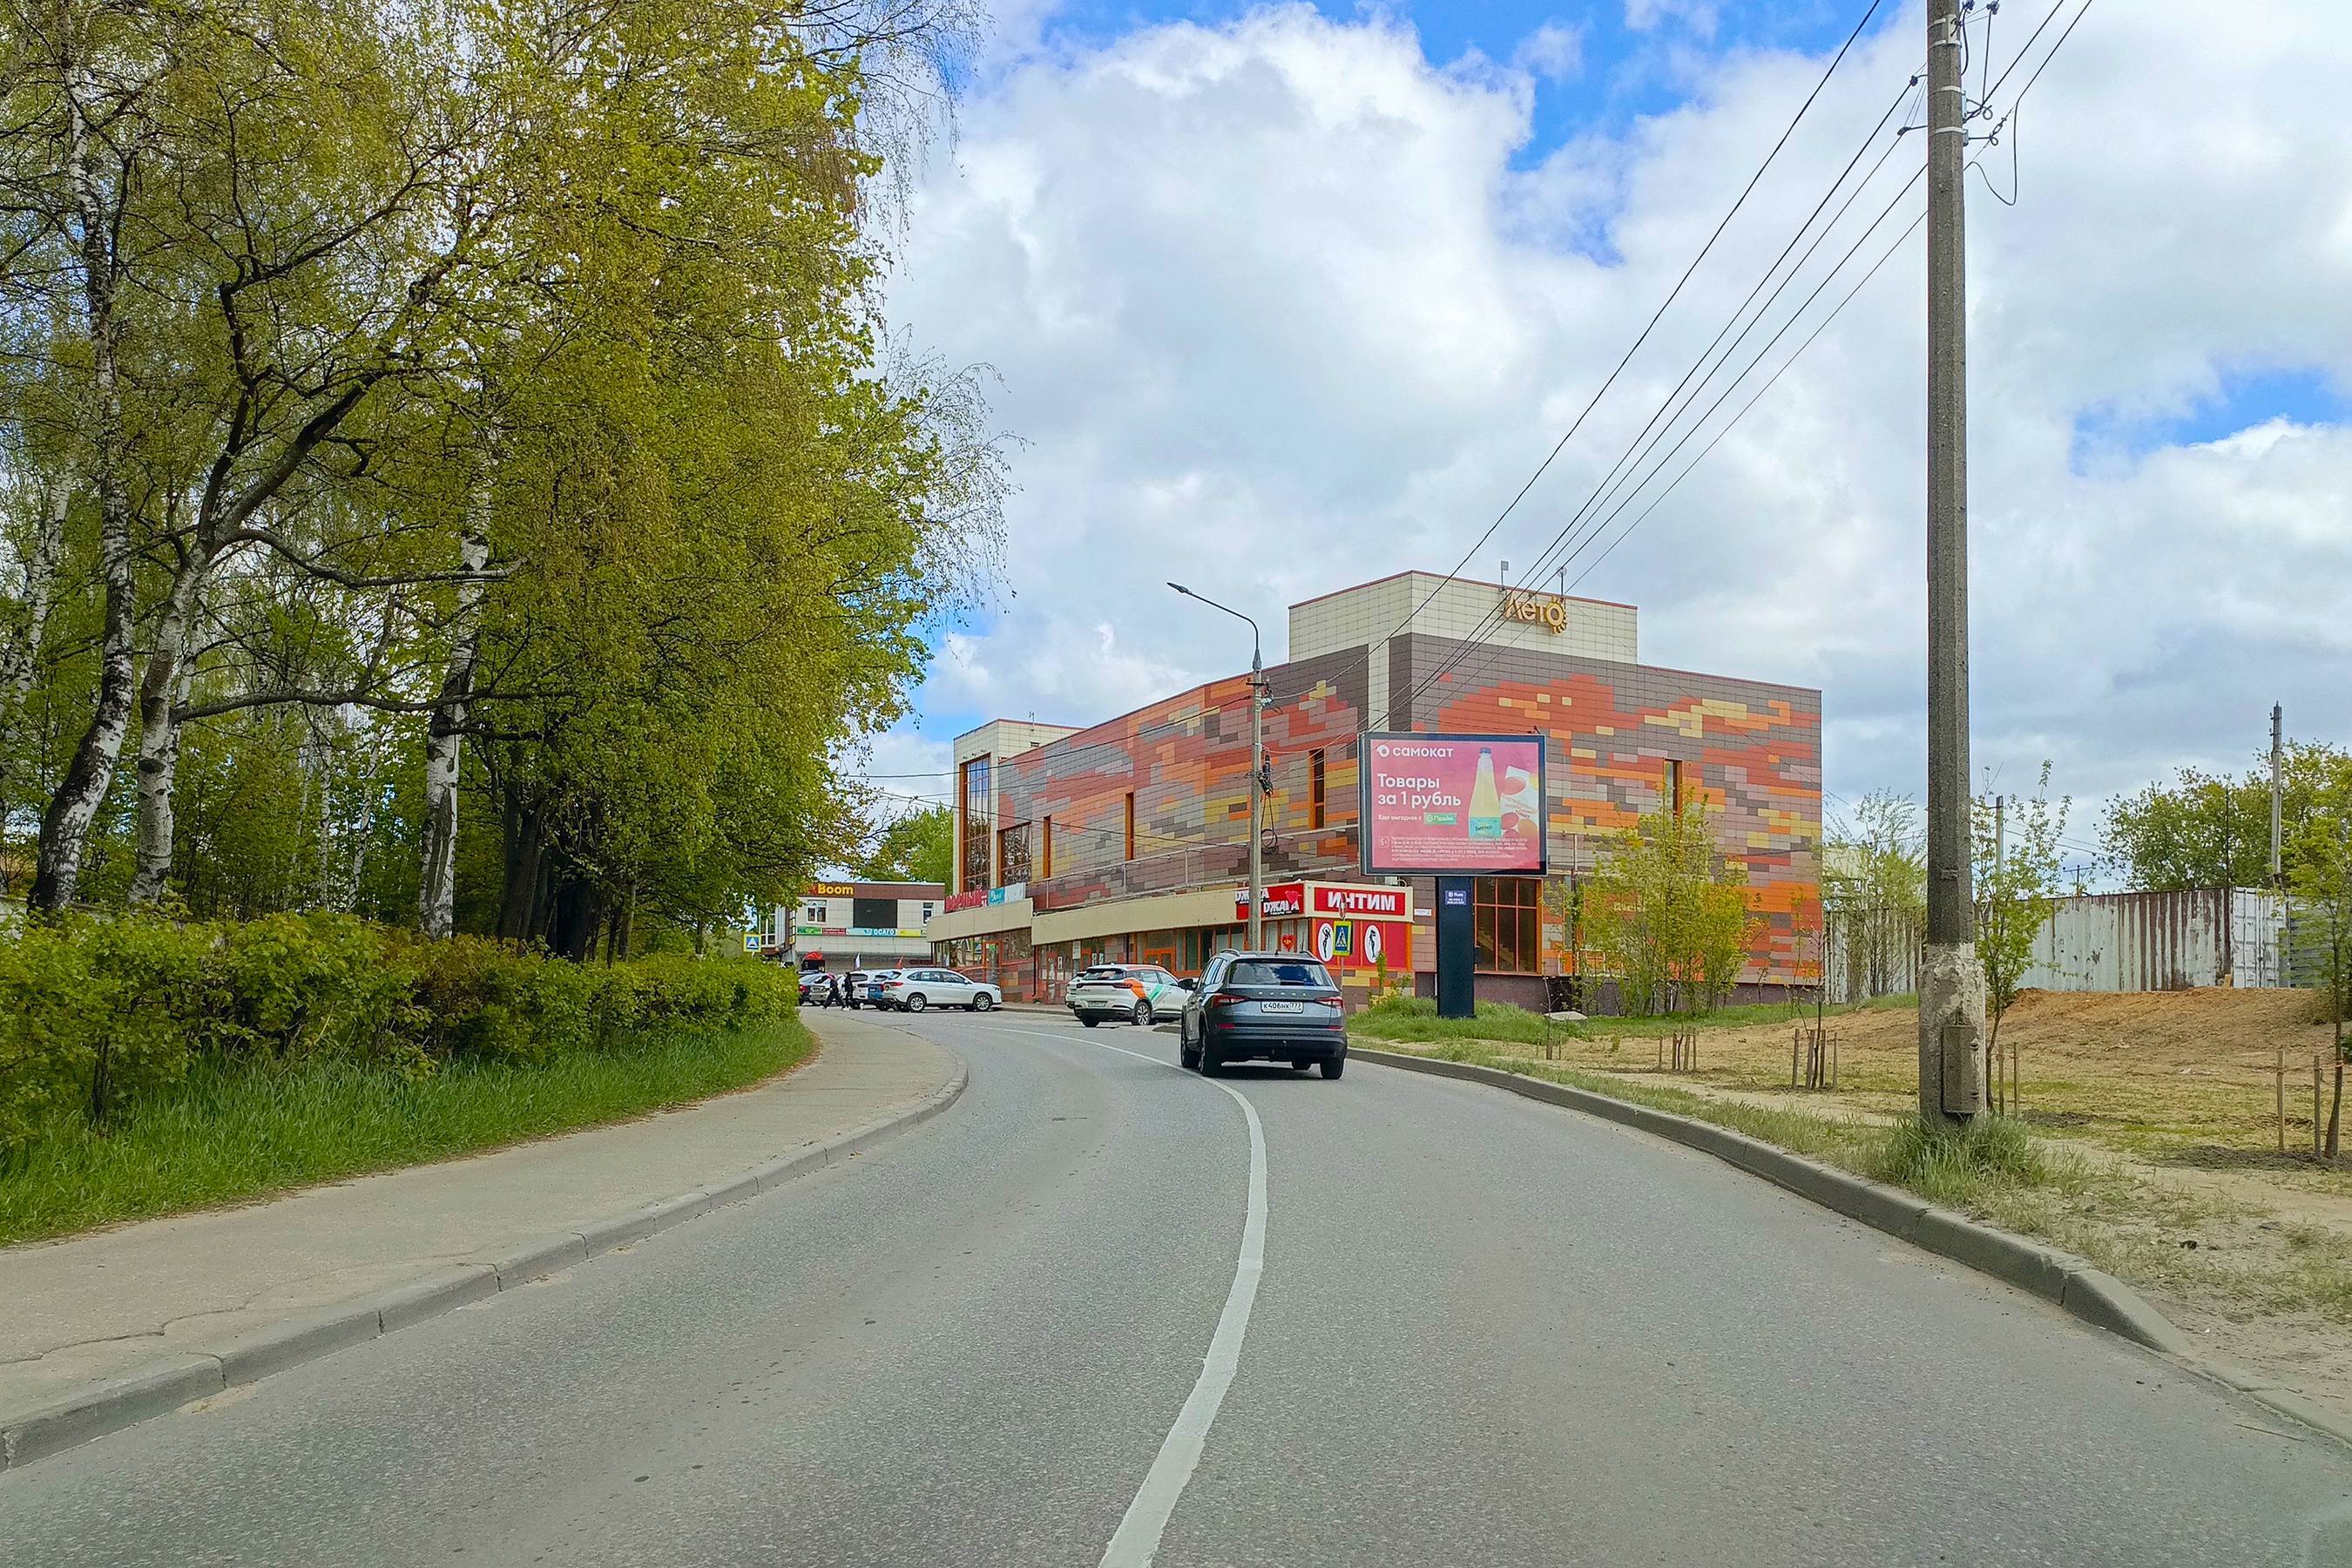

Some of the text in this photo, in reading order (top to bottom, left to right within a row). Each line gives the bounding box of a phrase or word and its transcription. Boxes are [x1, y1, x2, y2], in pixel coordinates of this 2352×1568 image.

[1393, 747, 1454, 757] самокат
[1377, 774, 1440, 792] Товары
[1378, 792, 1462, 809] за 1 рубль
[818, 883, 854, 895] Boom
[1328, 891, 1396, 911] ИНТИМ
